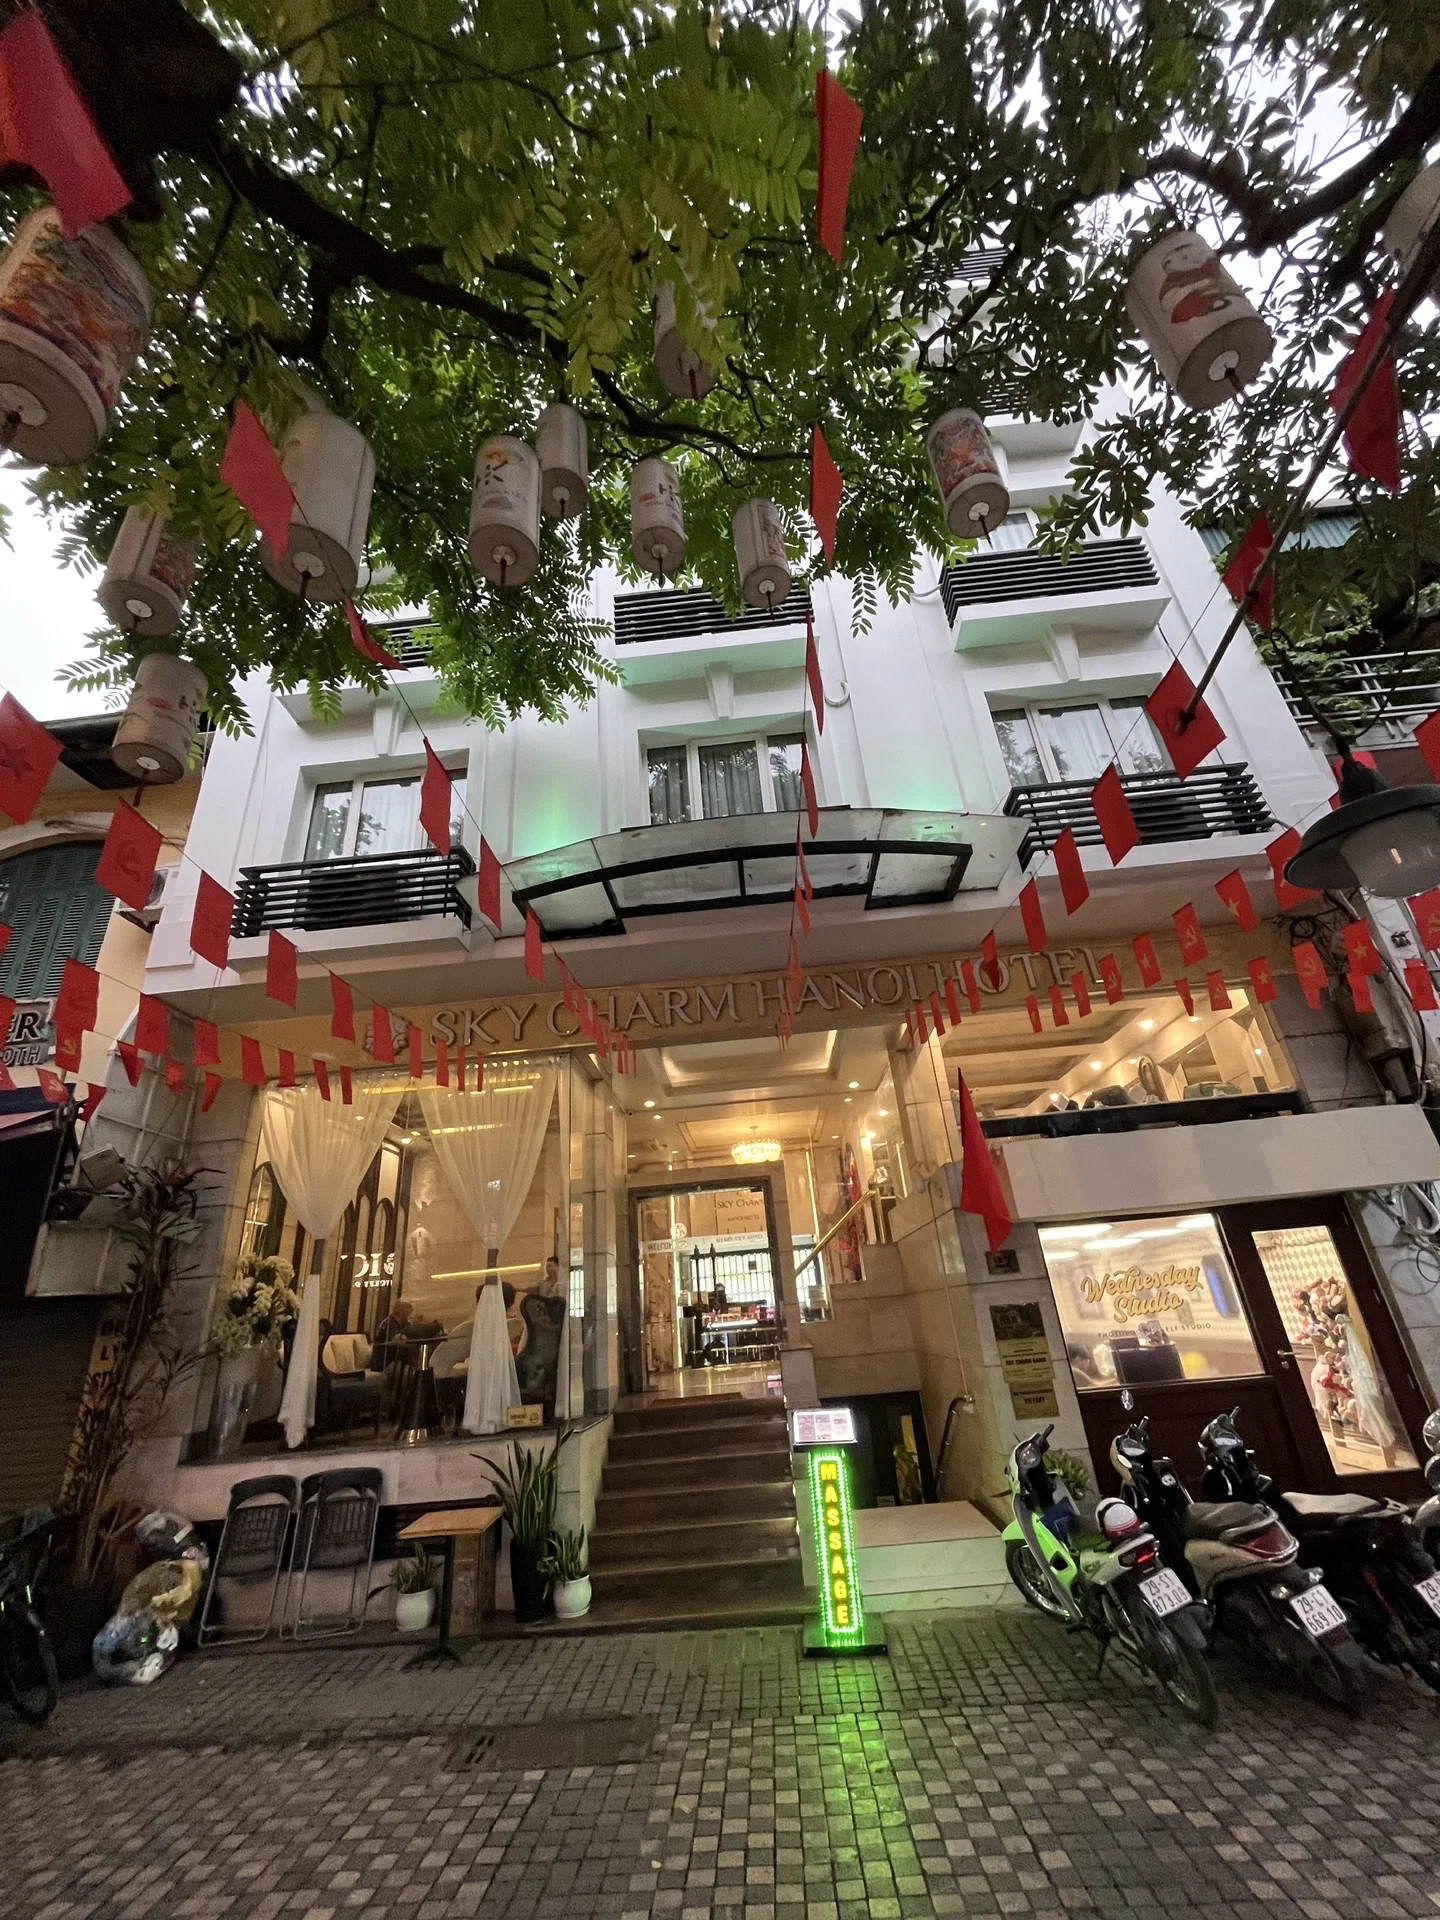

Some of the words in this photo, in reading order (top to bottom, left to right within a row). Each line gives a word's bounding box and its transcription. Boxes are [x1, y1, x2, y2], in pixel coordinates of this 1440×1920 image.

[429, 1001, 537, 1047] SKY
[546, 982, 741, 1038] CHARM
[753, 963, 922, 1018] HANOI
[928, 946, 1106, 1000] HOTEL
[1080, 1264, 1204, 1303] Wednesday
[1113, 1289, 1184, 1323] Studio
[1181, 1323, 1212, 1331] STUDIO
[819, 1463, 850, 1625] MASSAGE
[1152, 1586, 1188, 1613] 873.09
[1421, 1577, 1440, 1600] 29-
[1306, 1604, 1343, 1632] 669.10
